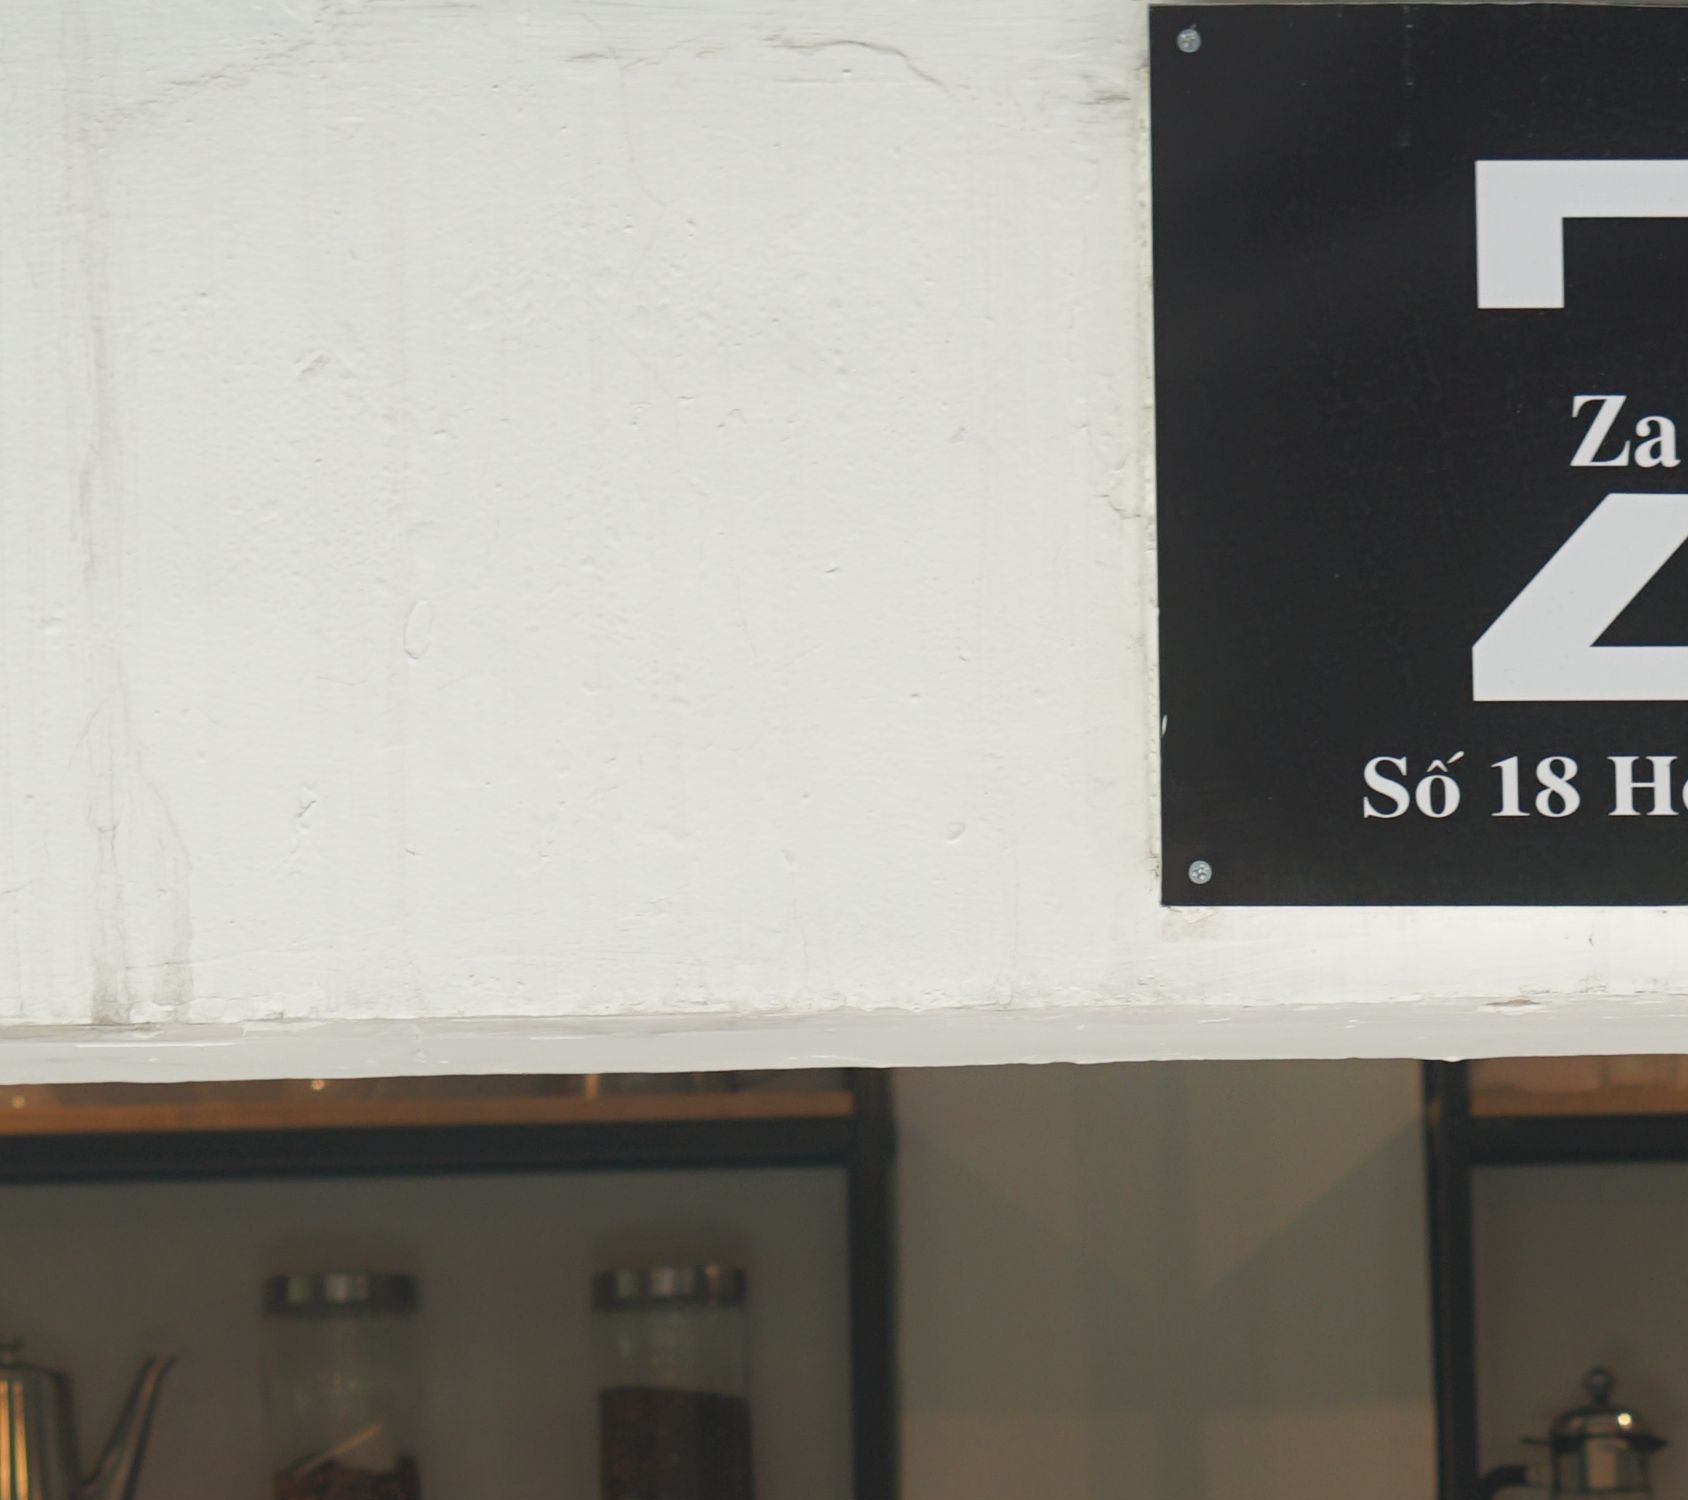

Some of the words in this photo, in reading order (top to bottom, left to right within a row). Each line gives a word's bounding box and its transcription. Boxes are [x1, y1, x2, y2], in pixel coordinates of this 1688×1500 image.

[1571, 395, 1680, 467] Za
[1364, 751, 1464, 818] Số
[1493, 756, 1580, 817] 18
